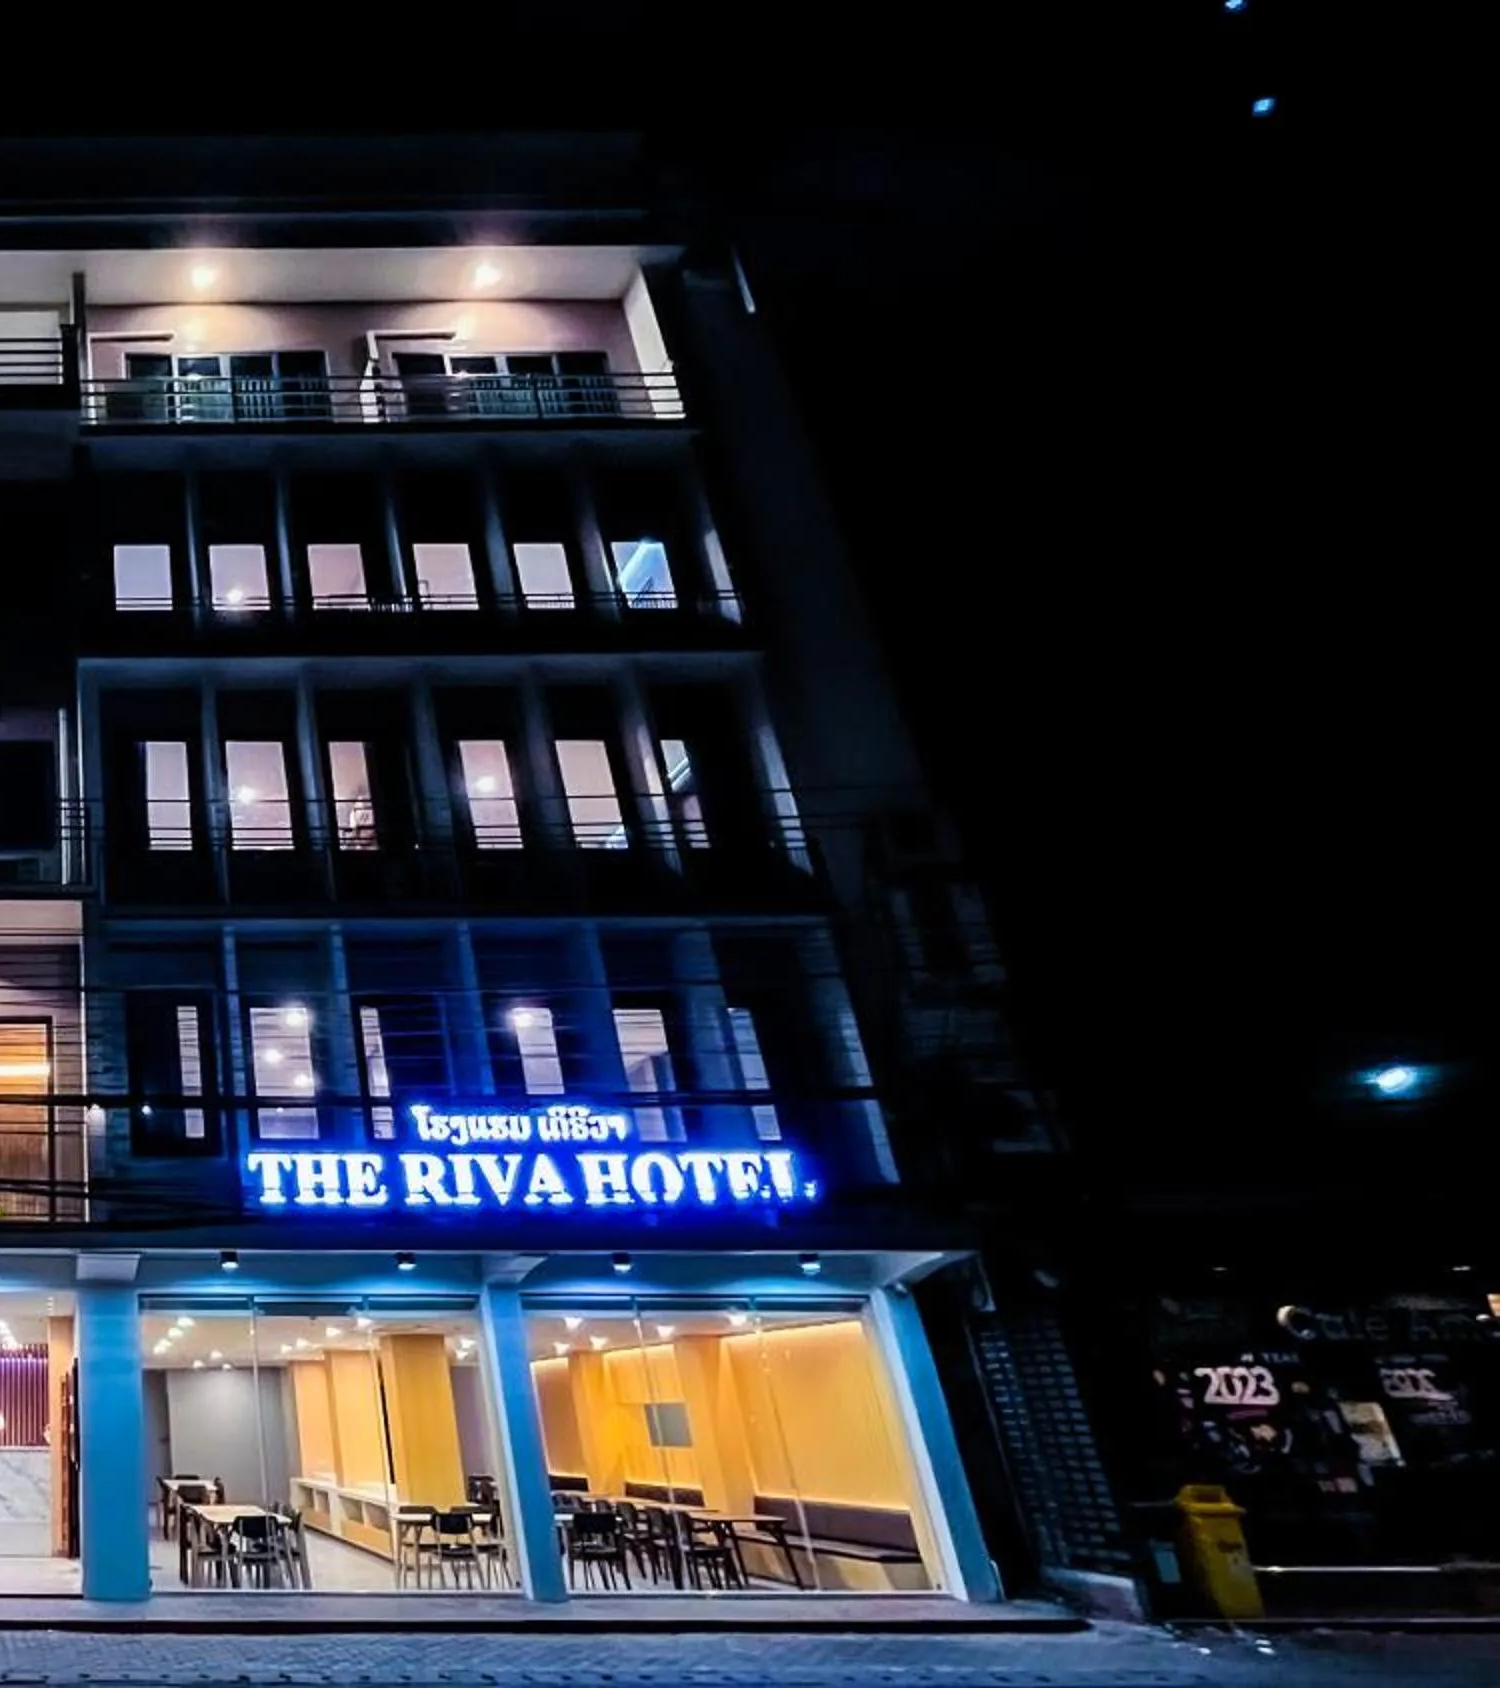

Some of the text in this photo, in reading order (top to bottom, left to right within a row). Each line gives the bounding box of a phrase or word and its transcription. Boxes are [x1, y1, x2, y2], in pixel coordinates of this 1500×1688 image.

[410, 1104, 532, 1146] โรงแรม
[247, 1151, 817, 1206] THE RIVA HOTEL
[1193, 1365, 1281, 1406] 2023
